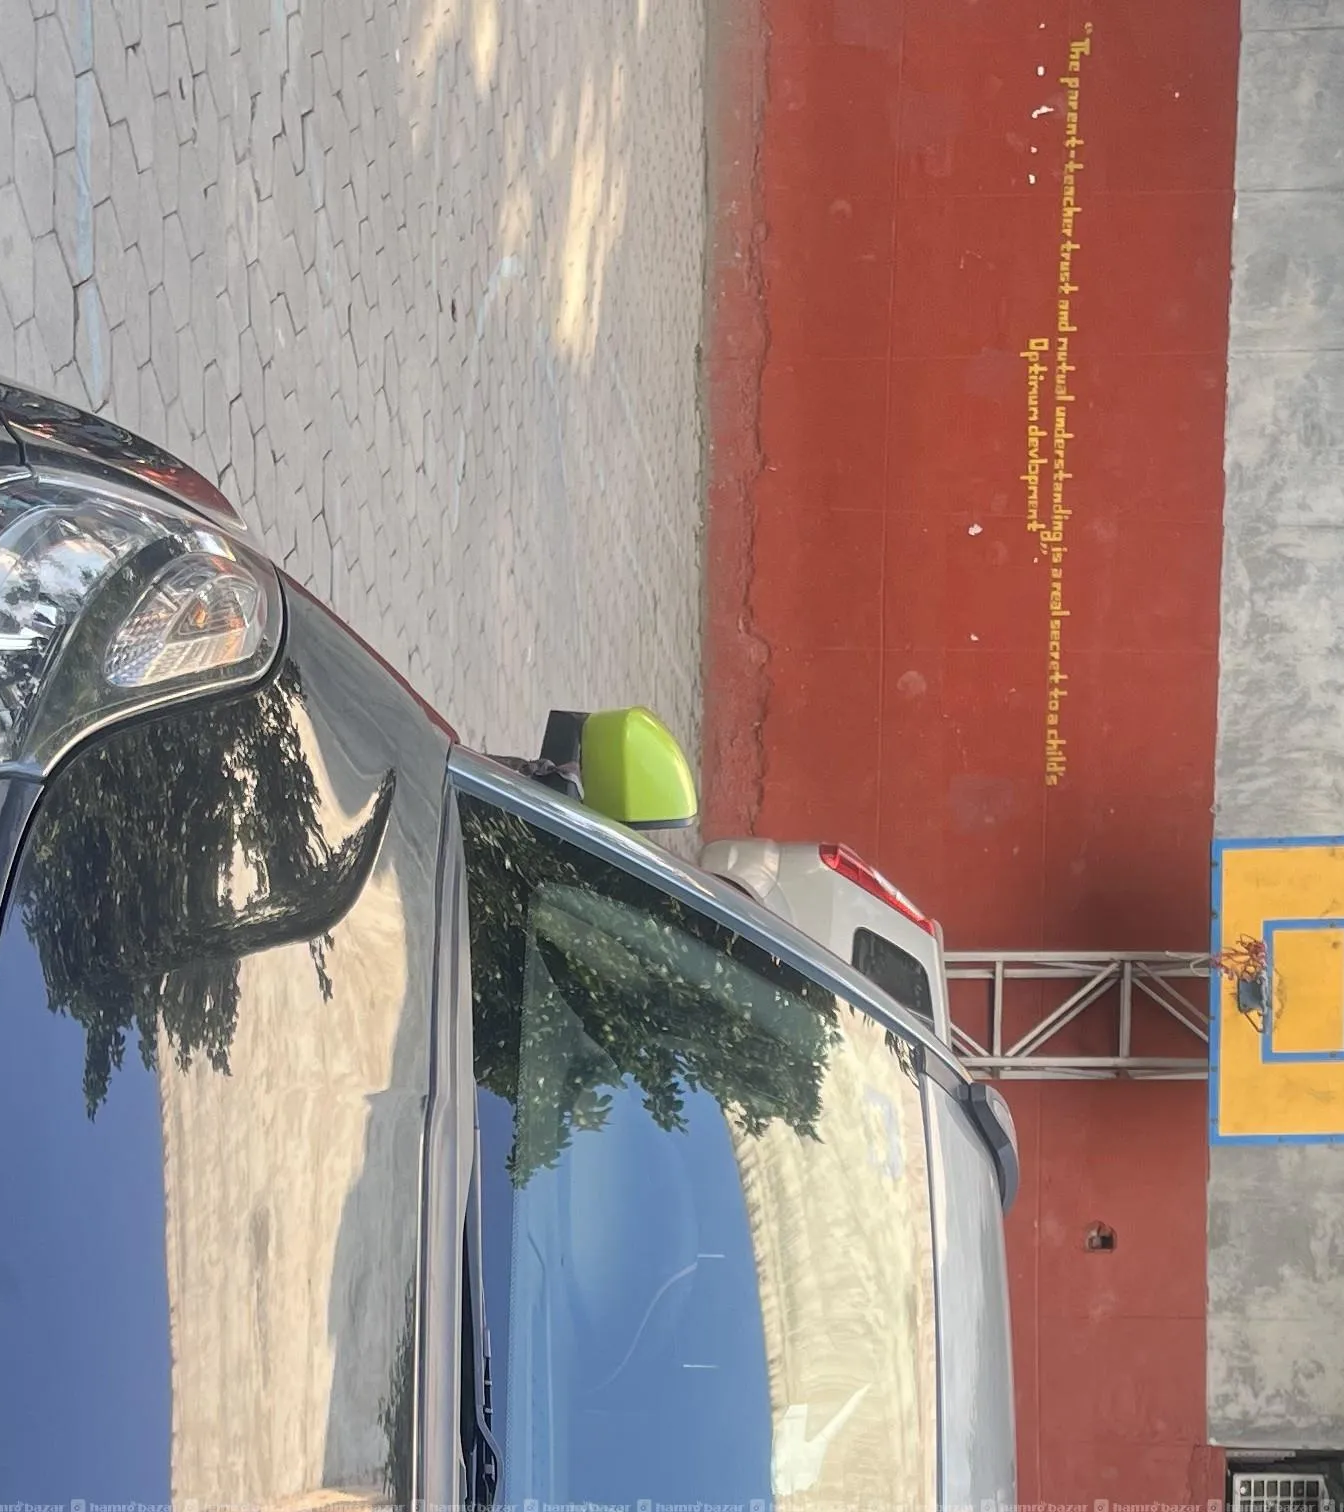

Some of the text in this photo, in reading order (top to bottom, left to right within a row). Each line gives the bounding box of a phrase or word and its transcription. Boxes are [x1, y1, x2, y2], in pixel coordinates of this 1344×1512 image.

[1057, 240, 1079, 294] trust
[1056, 300, 1076, 332] and
[1019, 338, 1049, 421] Optimum
[1054, 337, 1074, 400] mutual
[1039, 406, 1073, 542] understanding
[1049, 547, 1067, 564] is
[1050, 568, 1062, 580] a
[1049, 582, 1069, 616] real
[1047, 619, 1067, 684] secret
[1046, 688, 1067, 710] to
[1046, 714, 1058, 726] a
